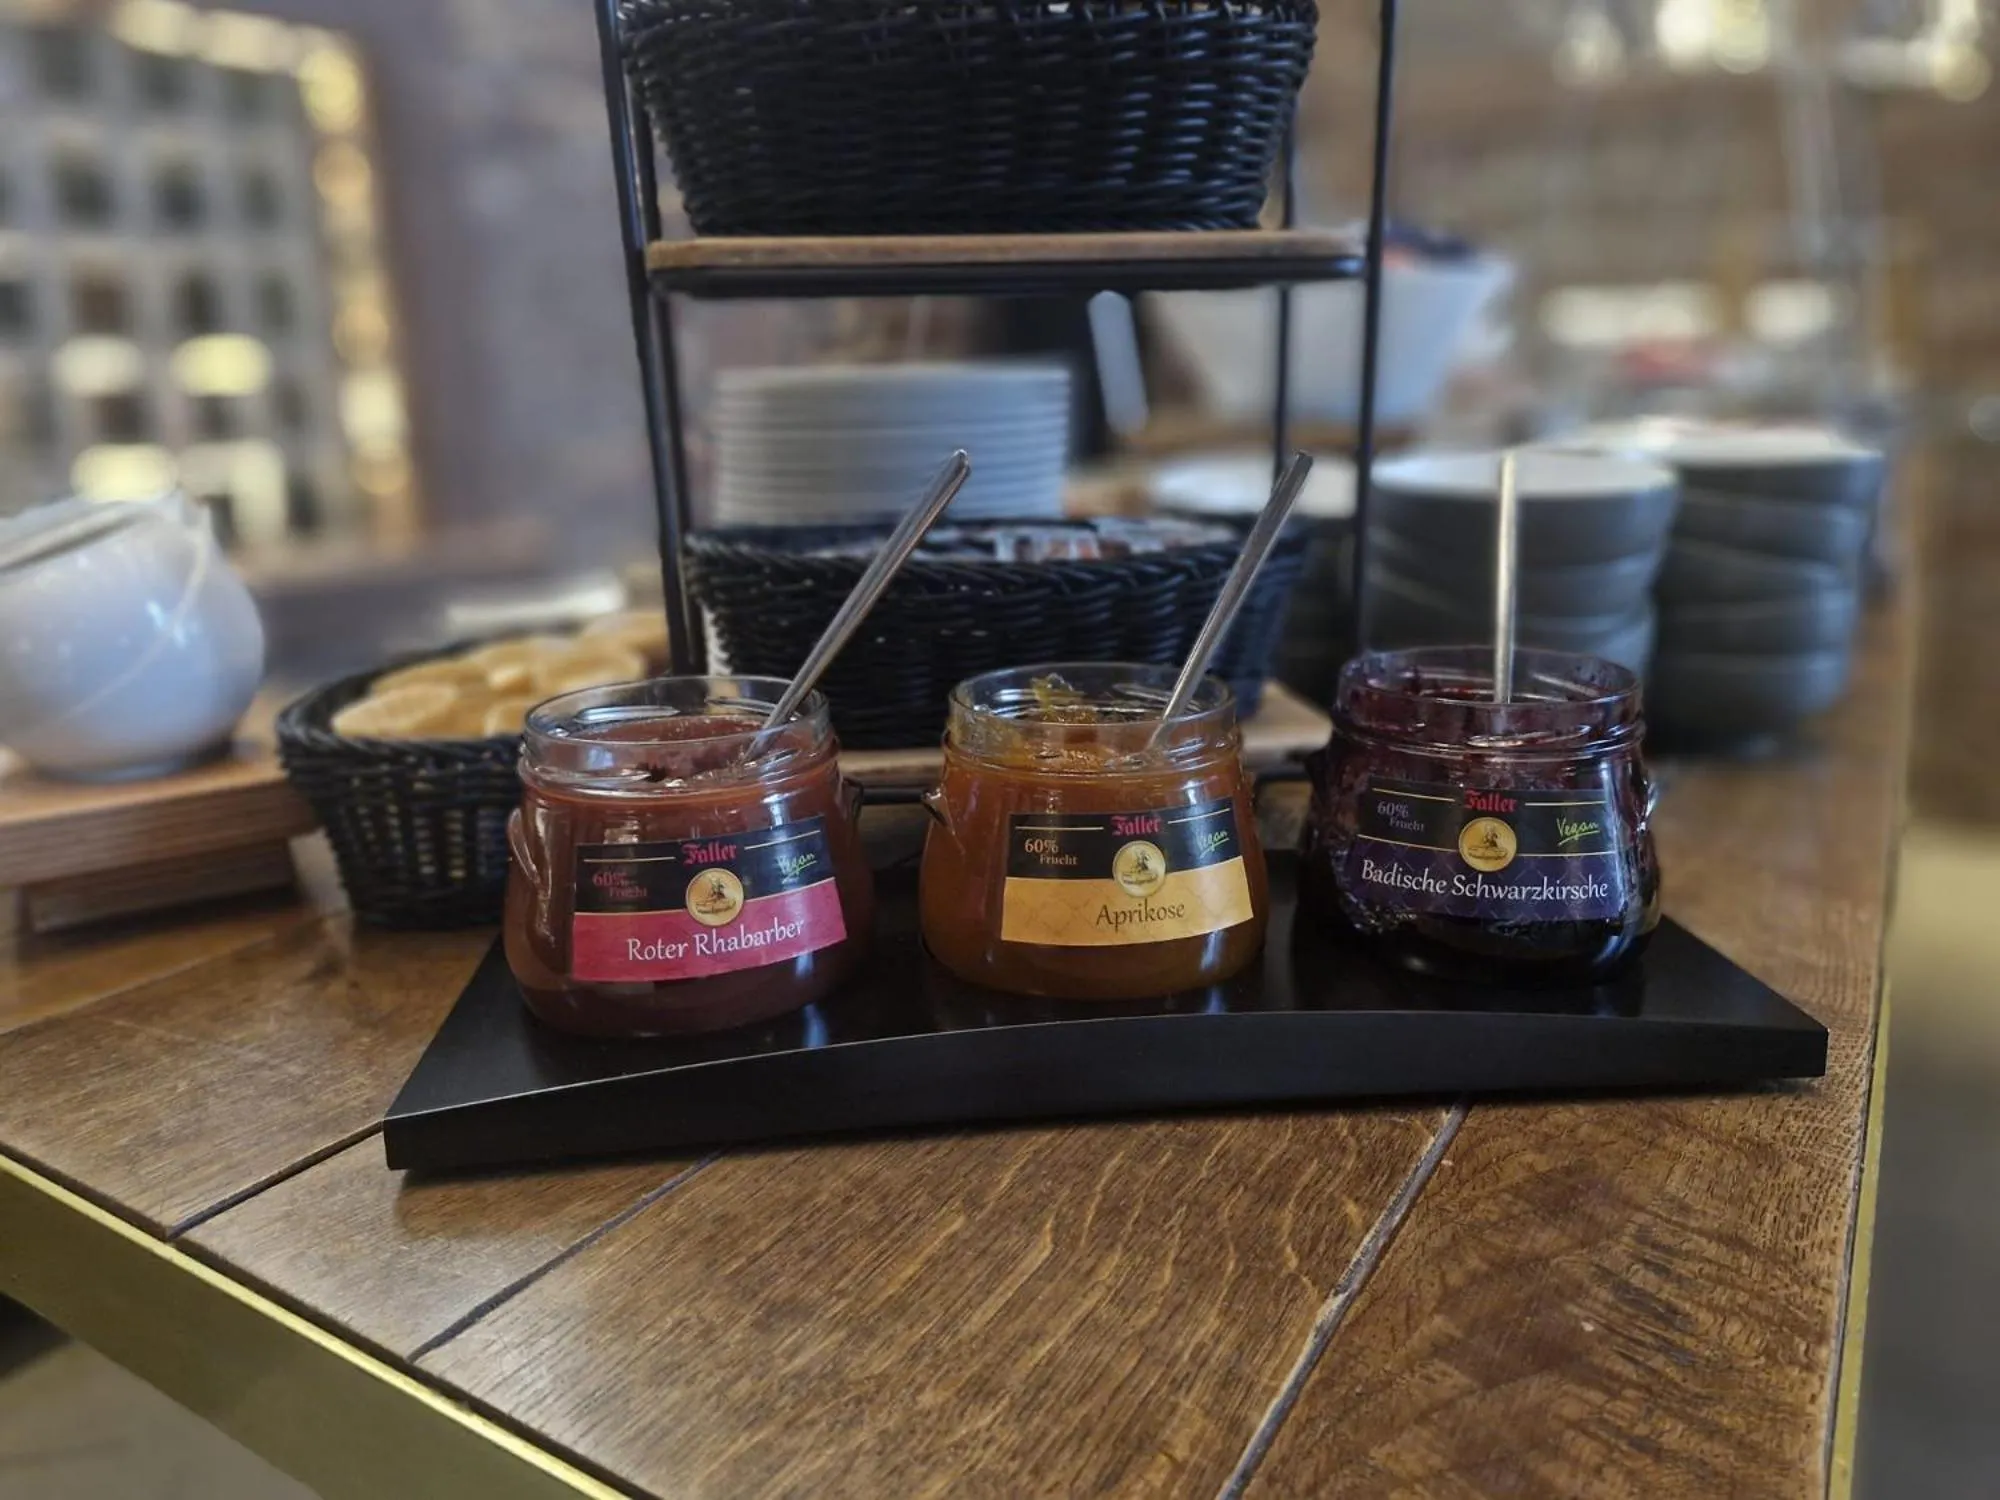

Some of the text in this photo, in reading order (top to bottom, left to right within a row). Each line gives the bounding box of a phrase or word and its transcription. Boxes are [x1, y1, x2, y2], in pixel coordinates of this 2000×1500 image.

[1377, 801, 1409, 818] 60%
[1464, 787, 1517, 812] Faller
[1111, 815, 1162, 836] Faller
[1389, 817, 1425, 832] Frucht
[1556, 817, 1599, 840] Vegan
[682, 841, 737, 866] Faller
[1025, 838, 1059, 854] 60%
[777, 852, 816, 876] Vegan
[1039, 854, 1078, 866] Frucht
[1361, 859, 1608, 901] Badische Schwarzkirsche
[1096, 899, 1186, 932] Aprikose
[627, 916, 804, 961] Roter Rhabarber
